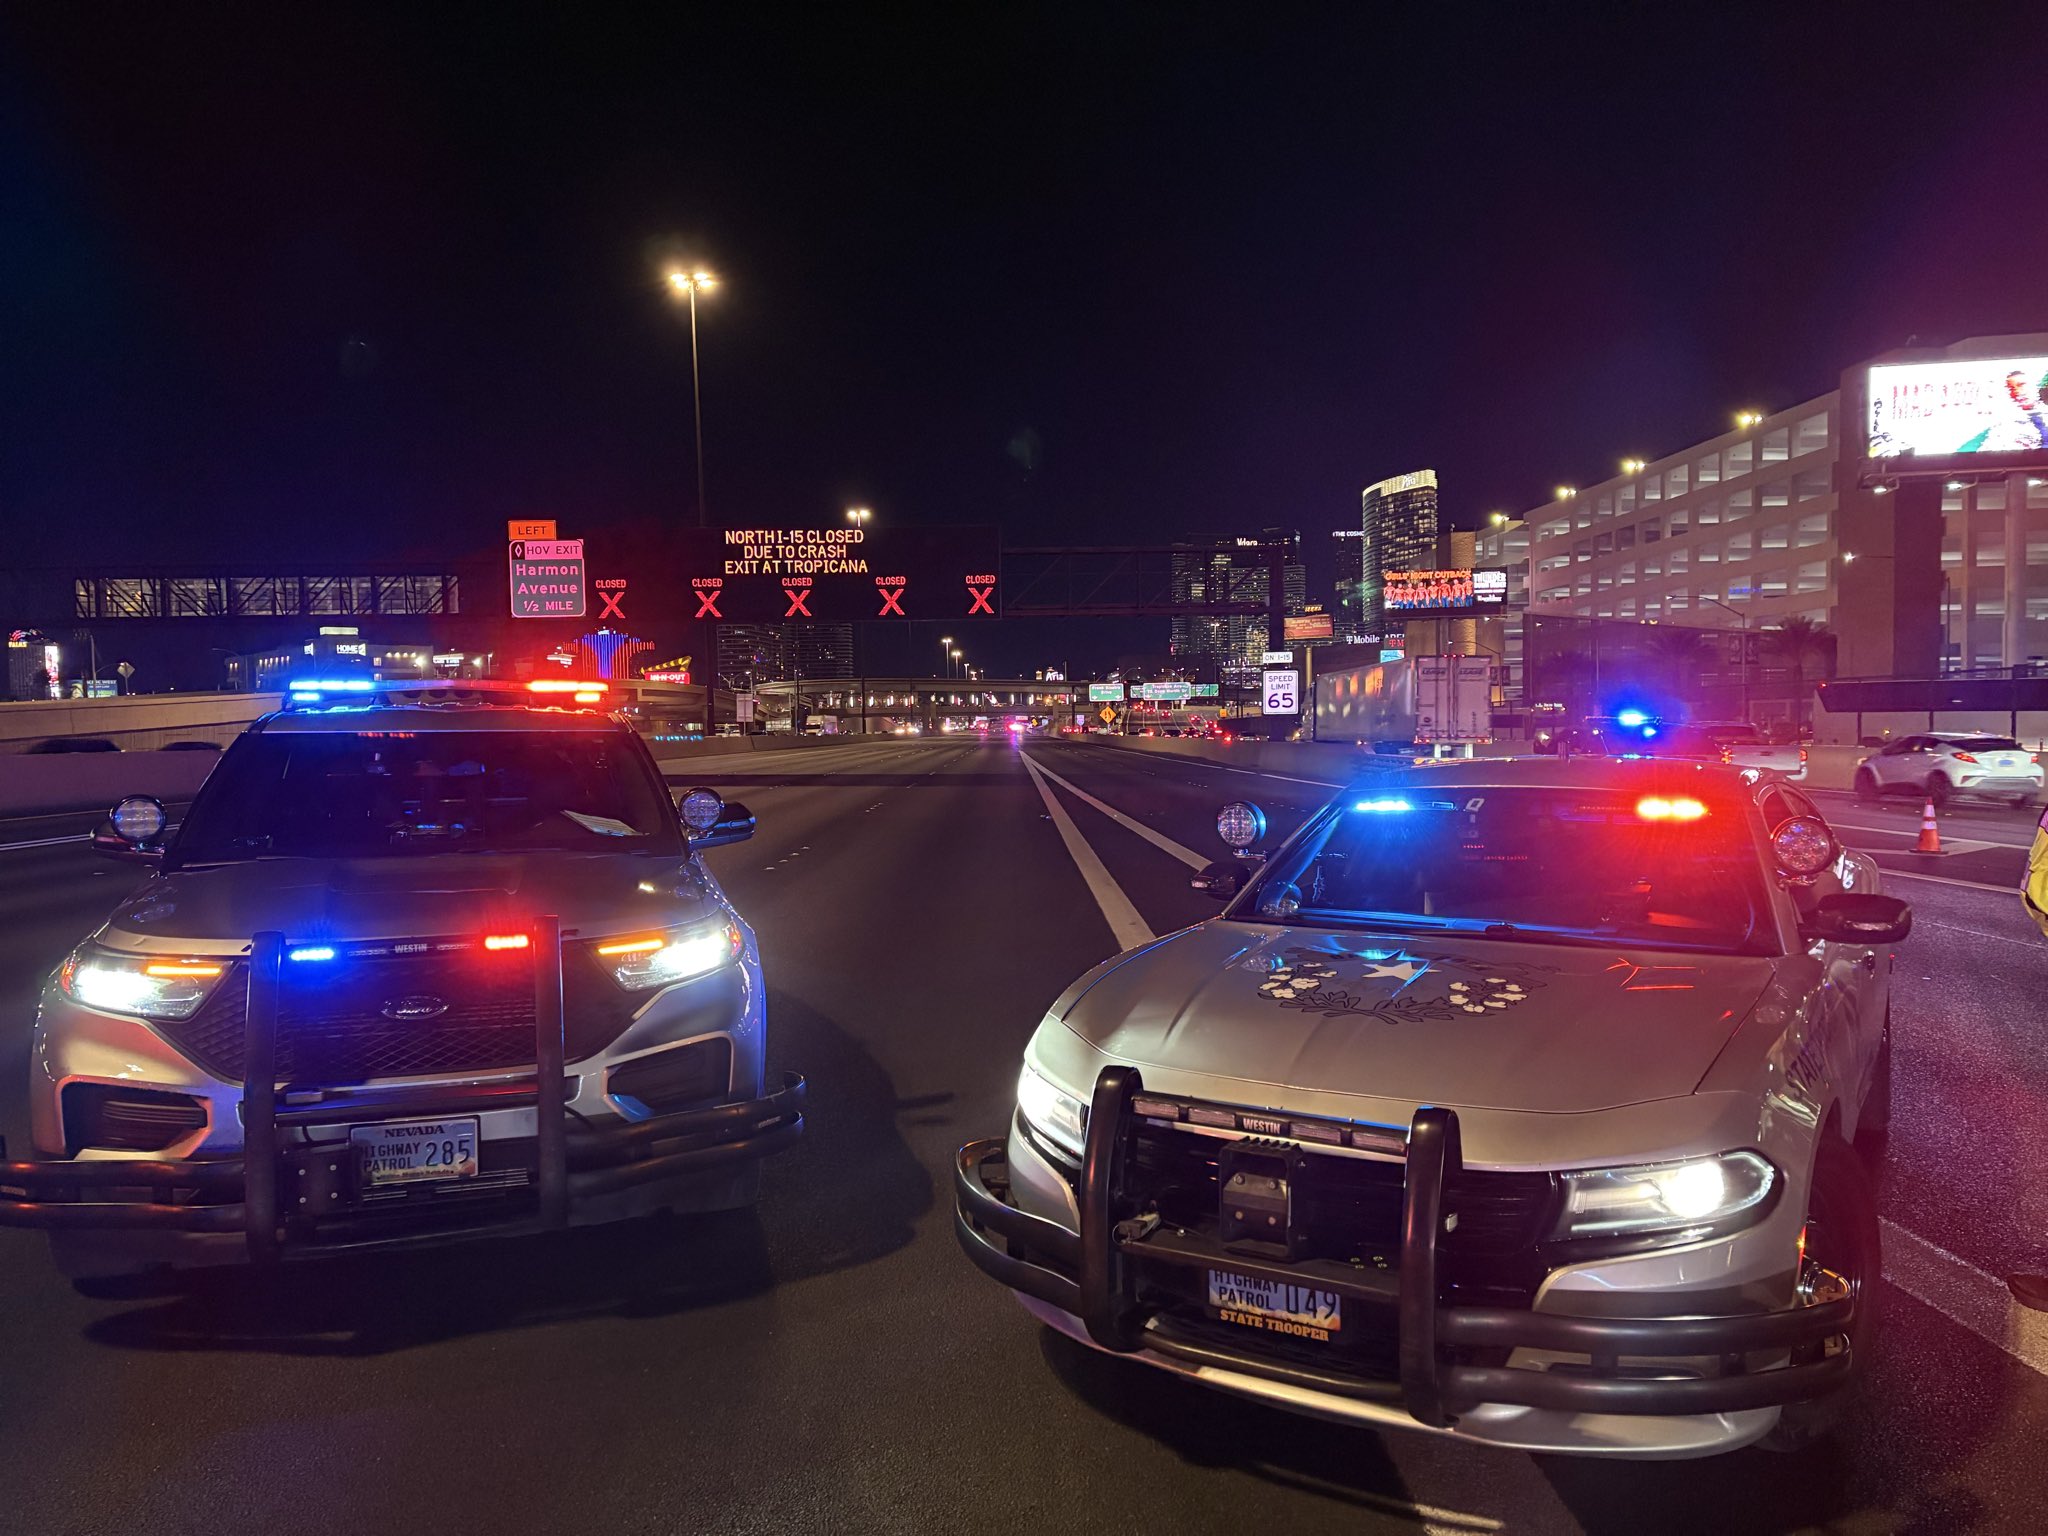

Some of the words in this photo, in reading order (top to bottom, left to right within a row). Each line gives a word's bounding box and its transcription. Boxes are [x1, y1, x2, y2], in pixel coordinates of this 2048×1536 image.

[518, 526, 547, 535] LEFT
[725, 530, 774, 544] NORTH
[777, 530, 803, 544] I-15
[806, 529, 864, 543] CLOSED
[526, 545, 550, 555] HOV
[556, 545, 580, 554] EXIT
[744, 545, 773, 559] DUE
[776, 545, 795, 559] TO
[798, 544, 846, 558] CRASH
[516, 564, 578, 576] Harmon
[725, 560, 759, 574] EXIT
[762, 560, 781, 574] AT
[784, 559, 868, 574] TROPICANA
[595, 579, 627, 588] CLOSED
[692, 578, 722, 587] CLOSED
[781, 577, 812, 586] CLOSED
[875, 576, 906, 586] CLOSED
[965, 575, 995, 584] CLOSED
[517, 583, 578, 594] Avenue
[545, 601, 573, 610] MILE
[1046, 672, 1064, 681] Aria
[1268, 693, 1294, 709] 65
[395, 943, 427, 953] WESTIN
[384, 1124, 445, 1138] NEVADA
[1243, 1118, 1281, 1134] WESTIN
[425, 1139, 470, 1167] 285
[364, 1156, 417, 1172] PATROL
[1214, 1270, 1279, 1294] HIGHWAY
[1218, 1286, 1274, 1310] PATROL
[1220, 1309, 1263, 1329] STATE
[1265, 1319, 1329, 1342] TROOPER
